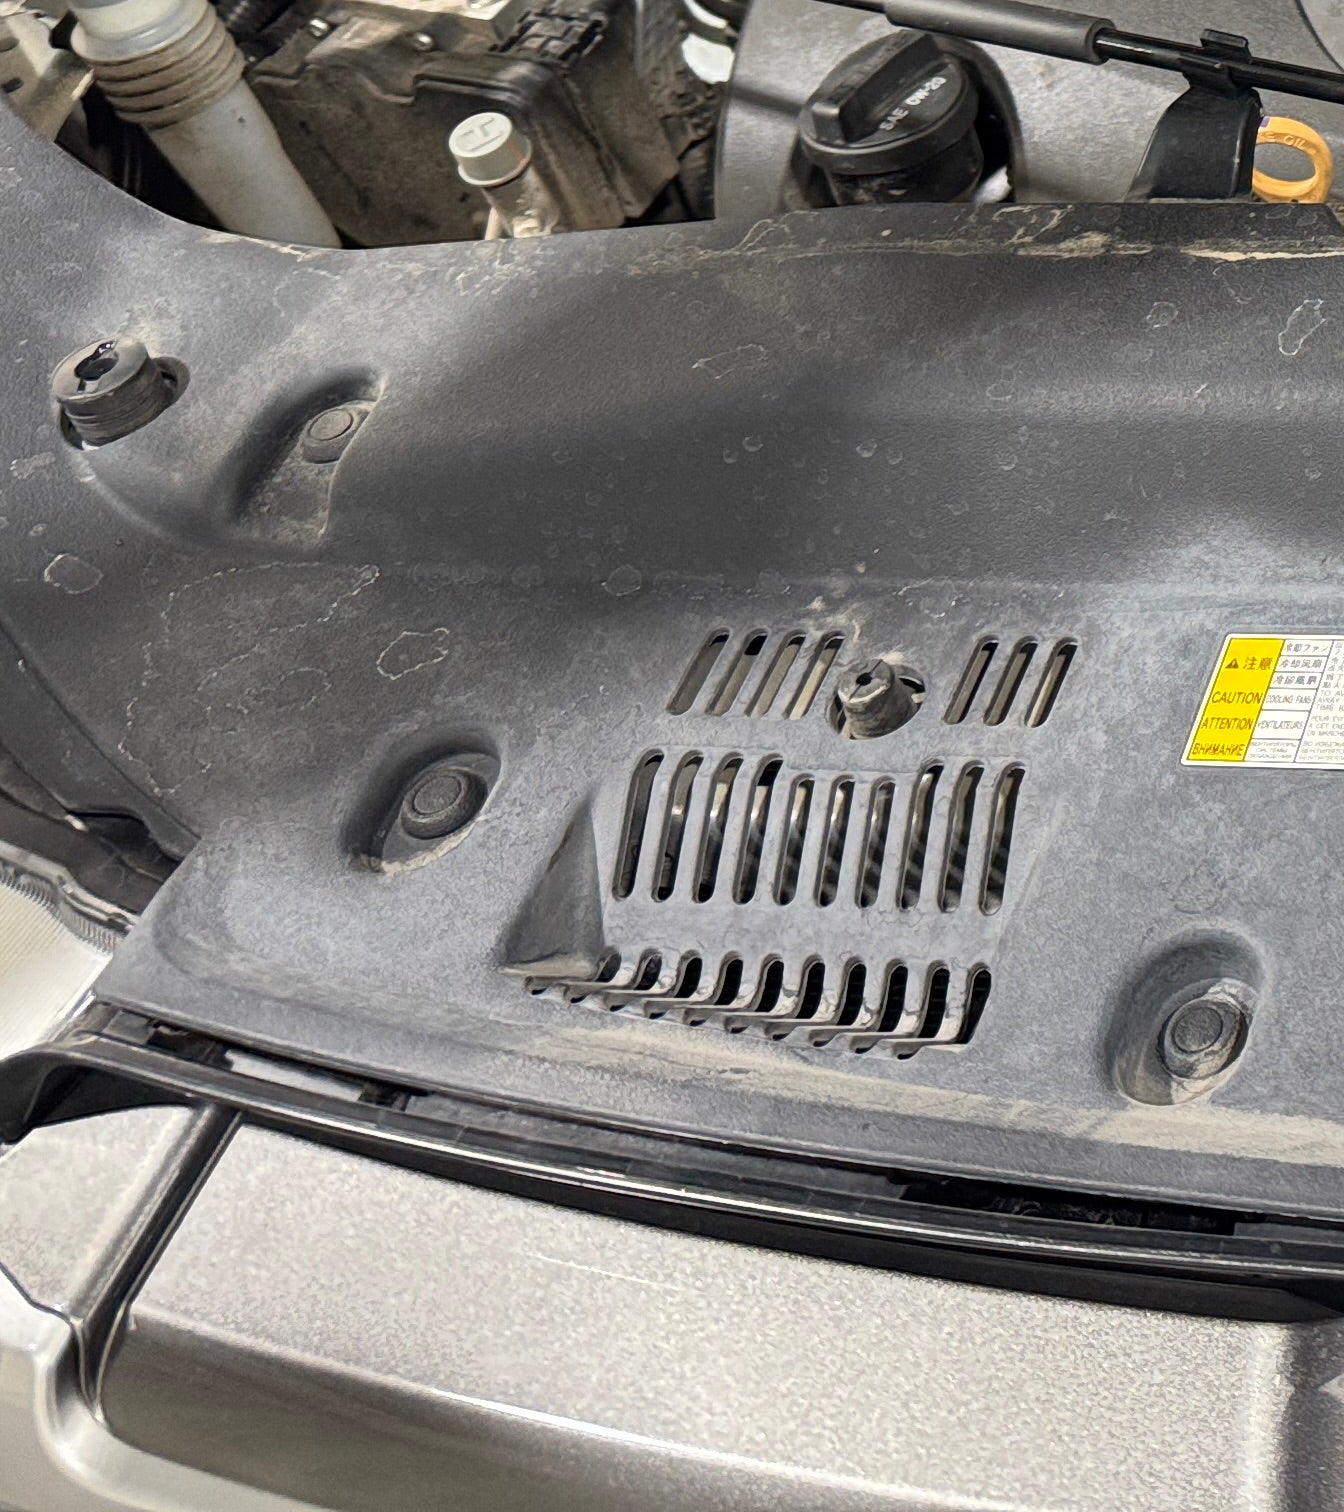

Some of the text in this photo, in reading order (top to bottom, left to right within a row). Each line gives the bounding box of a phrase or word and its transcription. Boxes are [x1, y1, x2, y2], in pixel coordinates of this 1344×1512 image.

[879, 76, 947, 132] SAE 0W-20
[1242, 656, 1272, 671] 注意
[1211, 690, 1264, 704] CAUTION
[1266, 695, 1294, 704] COOLING
[1201, 716, 1255, 730] ATTENTION
[1192, 742, 1246, 756] ВНИМАНИЕ
